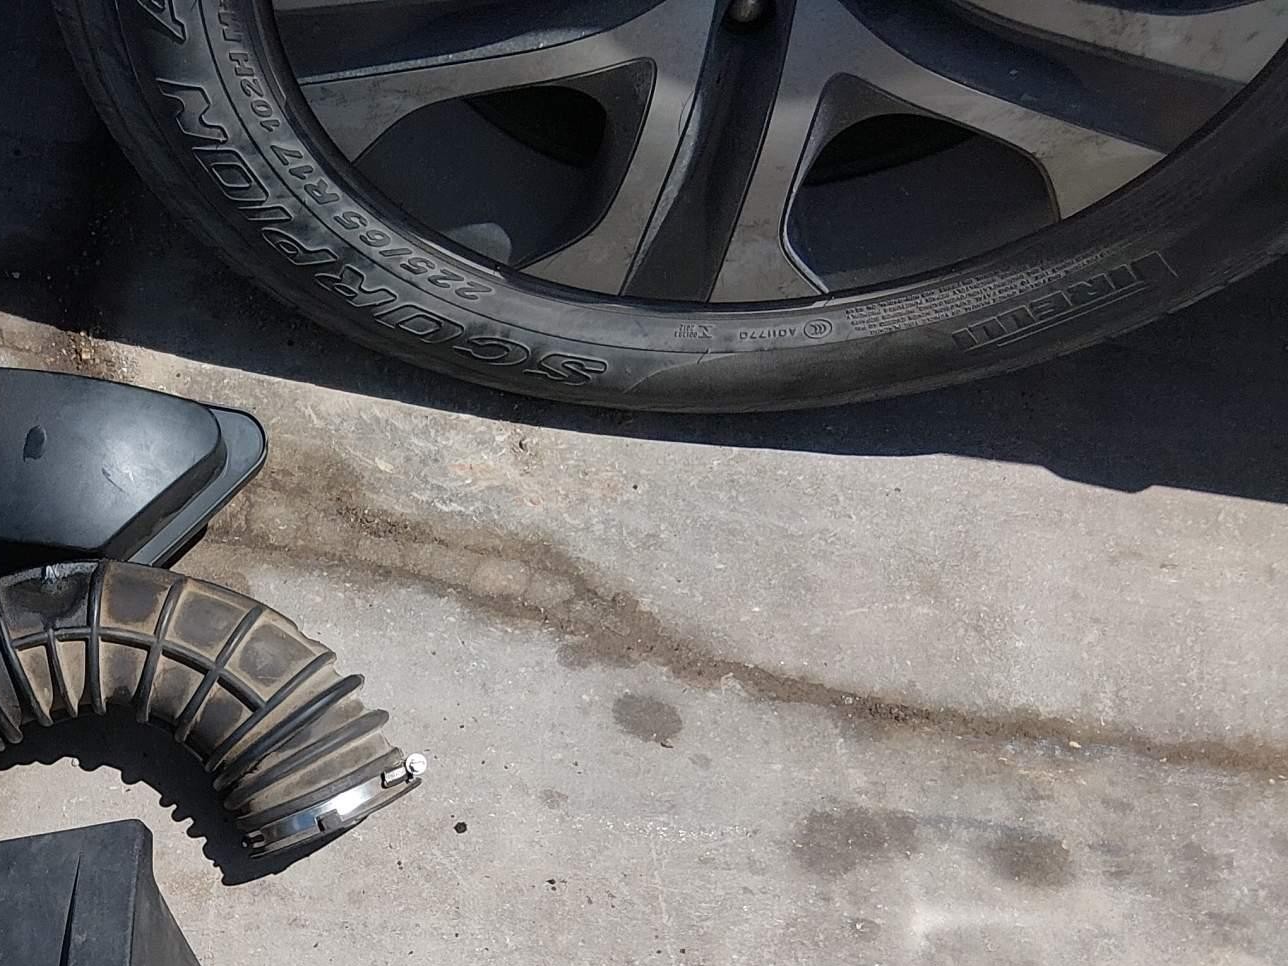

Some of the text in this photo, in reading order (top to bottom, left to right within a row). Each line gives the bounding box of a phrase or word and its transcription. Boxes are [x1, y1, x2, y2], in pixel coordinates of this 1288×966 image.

[228, 50, 280, 134] 102H
[270, 143, 341, 206] R17
[155, 77, 608, 386] SCORPION
[332, 210, 494, 302] 225/65
